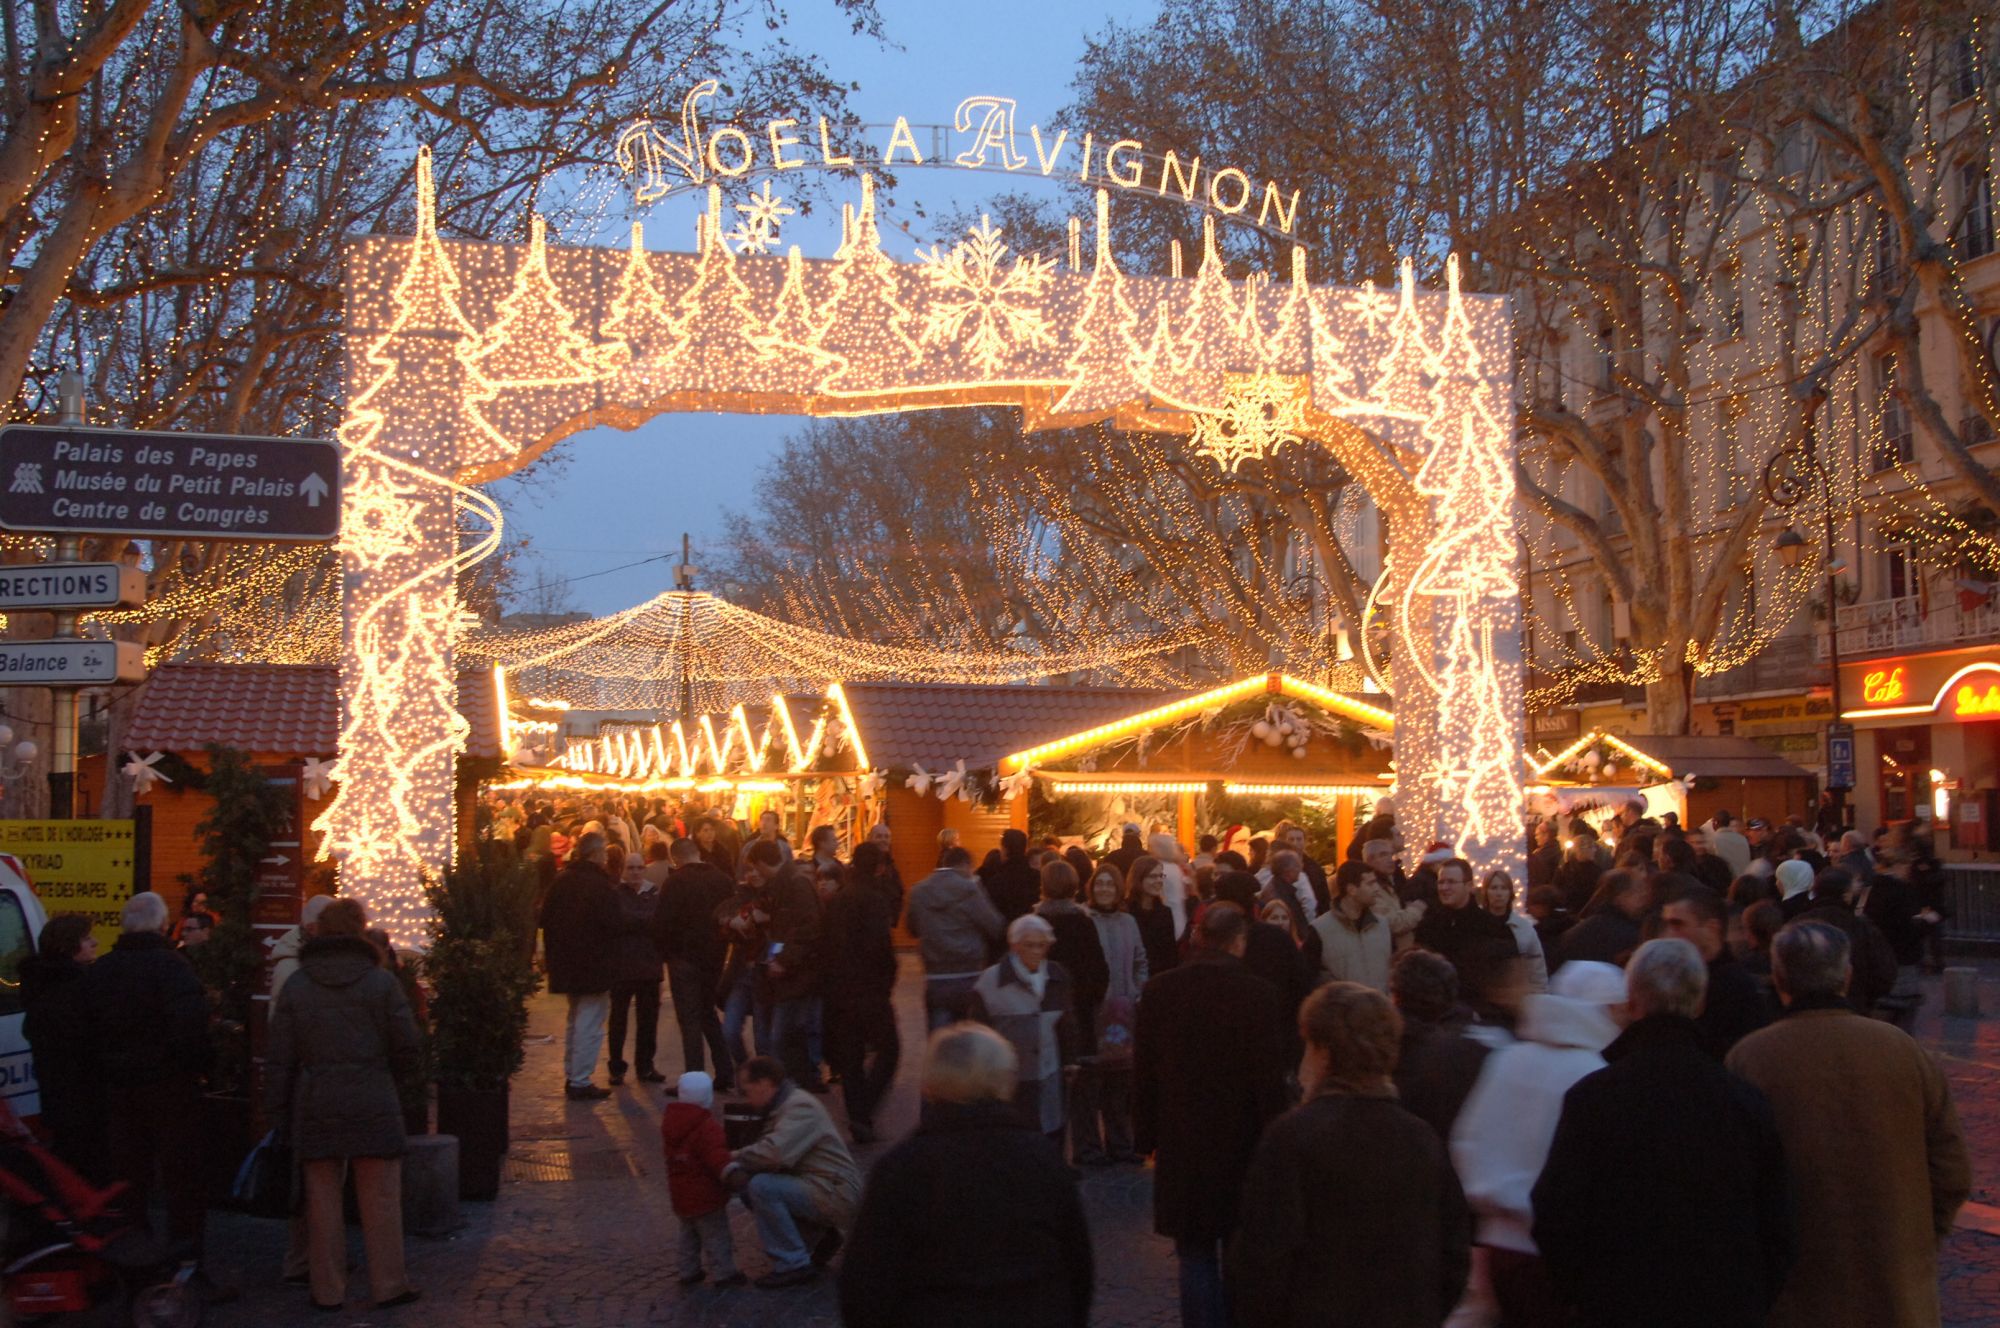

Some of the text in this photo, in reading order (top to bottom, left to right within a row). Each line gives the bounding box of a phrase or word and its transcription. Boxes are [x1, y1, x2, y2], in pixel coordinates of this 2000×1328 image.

[616, 78, 1300, 234] NOEL A AVIGNON
[53, 441, 258, 472] Palais des Papes
[54, 470, 294, 497] Musée du Petit Palais
[52, 498, 269, 528] Centre de Congrès
[0, 574, 108, 597] RECTIONS
[22, 854, 64, 870] KYRIAD
